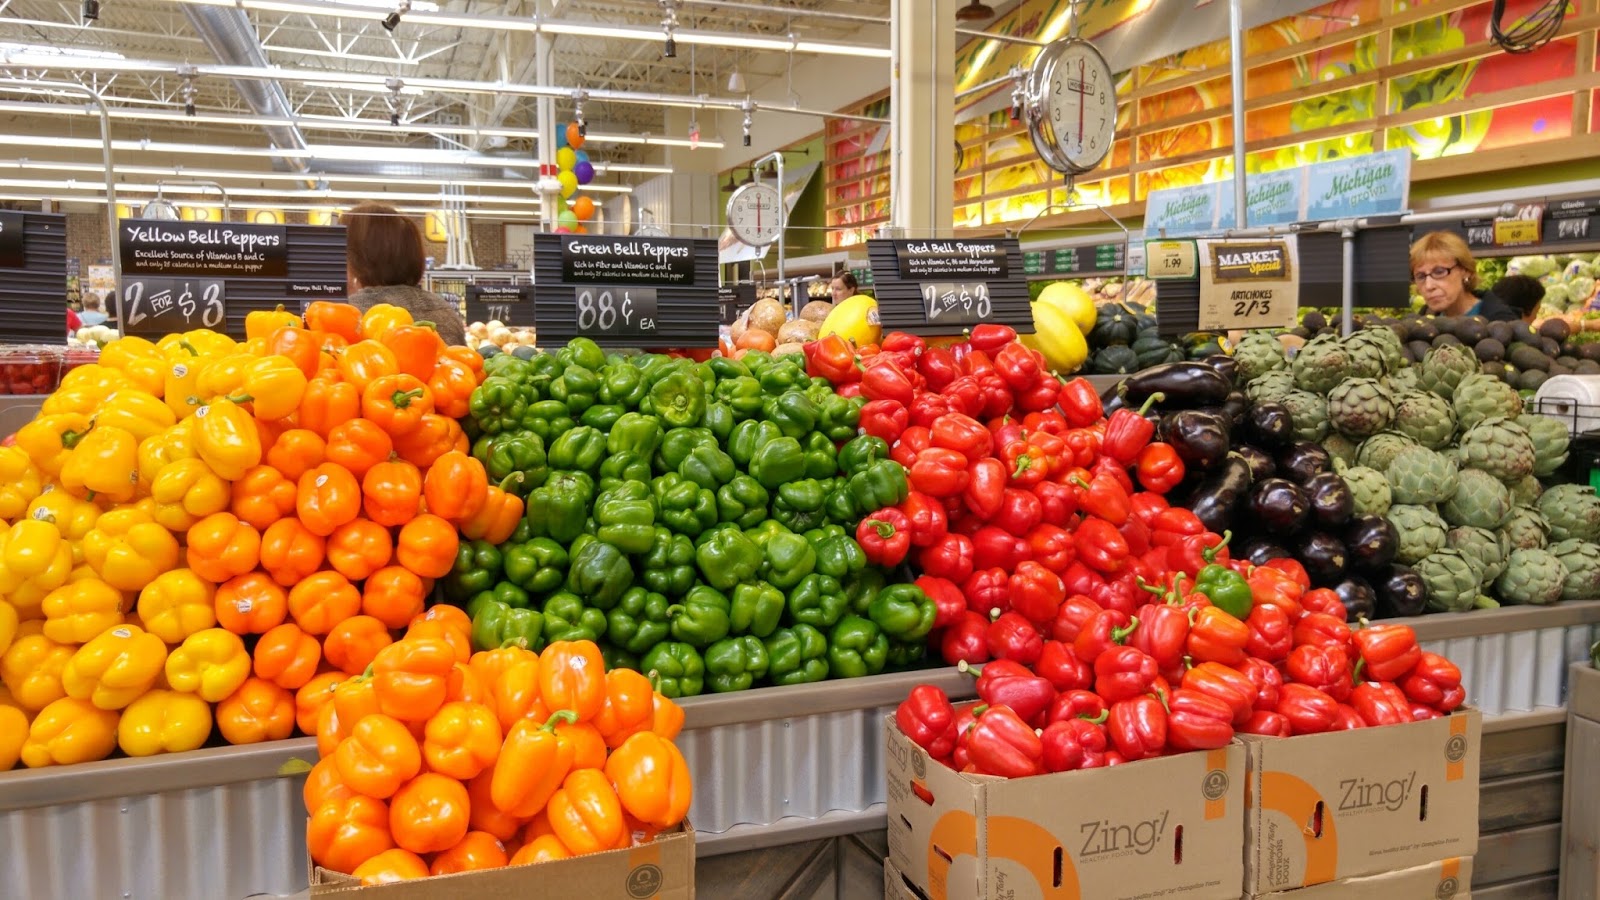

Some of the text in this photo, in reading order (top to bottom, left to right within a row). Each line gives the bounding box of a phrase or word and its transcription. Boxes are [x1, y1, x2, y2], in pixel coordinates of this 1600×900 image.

[1066, 62, 1069, 75] 1
[1091, 70, 1097, 82] 9
[1055, 81, 1062, 95] 2
[1100, 92, 1105, 105] 8
[1055, 108, 1061, 121] 3
[1100, 118, 1106, 131] 7
[1063, 131, 1069, 145] 4
[1090, 136, 1096, 149] 6
[1078, 141, 1082, 154] 5
[1325, 163, 1393, 200] Michigan
[1350, 184, 1387, 208] grown
[1159, 193, 1208, 222] Michigan
[1256, 199, 1286, 220] grown
[127, 226, 279, 253] Yellow Bell Peppers
[135, 249, 169, 259] Excellent
[170, 250, 195, 259] Source
[196, 250, 205, 261] of
[206, 250, 236, 260] Vitamins
[244, 252, 258, 260] and
[259, 253, 265, 261] C
[568, 241, 689, 263] Green Bell Peppers
[907, 242, 996, 258] Red Bell Peppers
[574, 260, 587, 268] Rich
[596, 260, 610, 268] Fiber
[611, 261, 623, 269] and
[624, 261, 649, 269] Vitamins
[968, 258, 994, 267] Magnesium
[1217, 249, 1280, 266] MARKET
[149, 260, 163, 270] only
[208, 261, 232, 269] medium
[244, 264, 263, 272] pepper
[918, 268, 928, 276] only
[988, 267, 1000, 275] pepper
[1250, 258, 1281, 275] Special
[584, 271, 595, 279] only
[292, 284, 311, 292] Orange
[323, 285, 342, 293] Peppers
[1231, 290, 1272, 300] ARTICHOKES
[125, 281, 147, 327] 2
[151, 295, 173, 312] FOR
[925, 285, 942, 320] 2
[942, 293, 957, 308] FOR
[640, 318, 655, 330] EA
[1338, 770, 1416, 811] Zing!
[1337, 806, 1385, 817] HEALTHY FOODS
[1079, 809, 1170, 857] Zing!
[1079, 849, 1134, 864] HEALTHY FOODS
[1275, 839, 1283, 885] POIVRONS
[1266, 843, 1277, 887] Amazingly
[1282, 857, 1290, 884] DOUX
